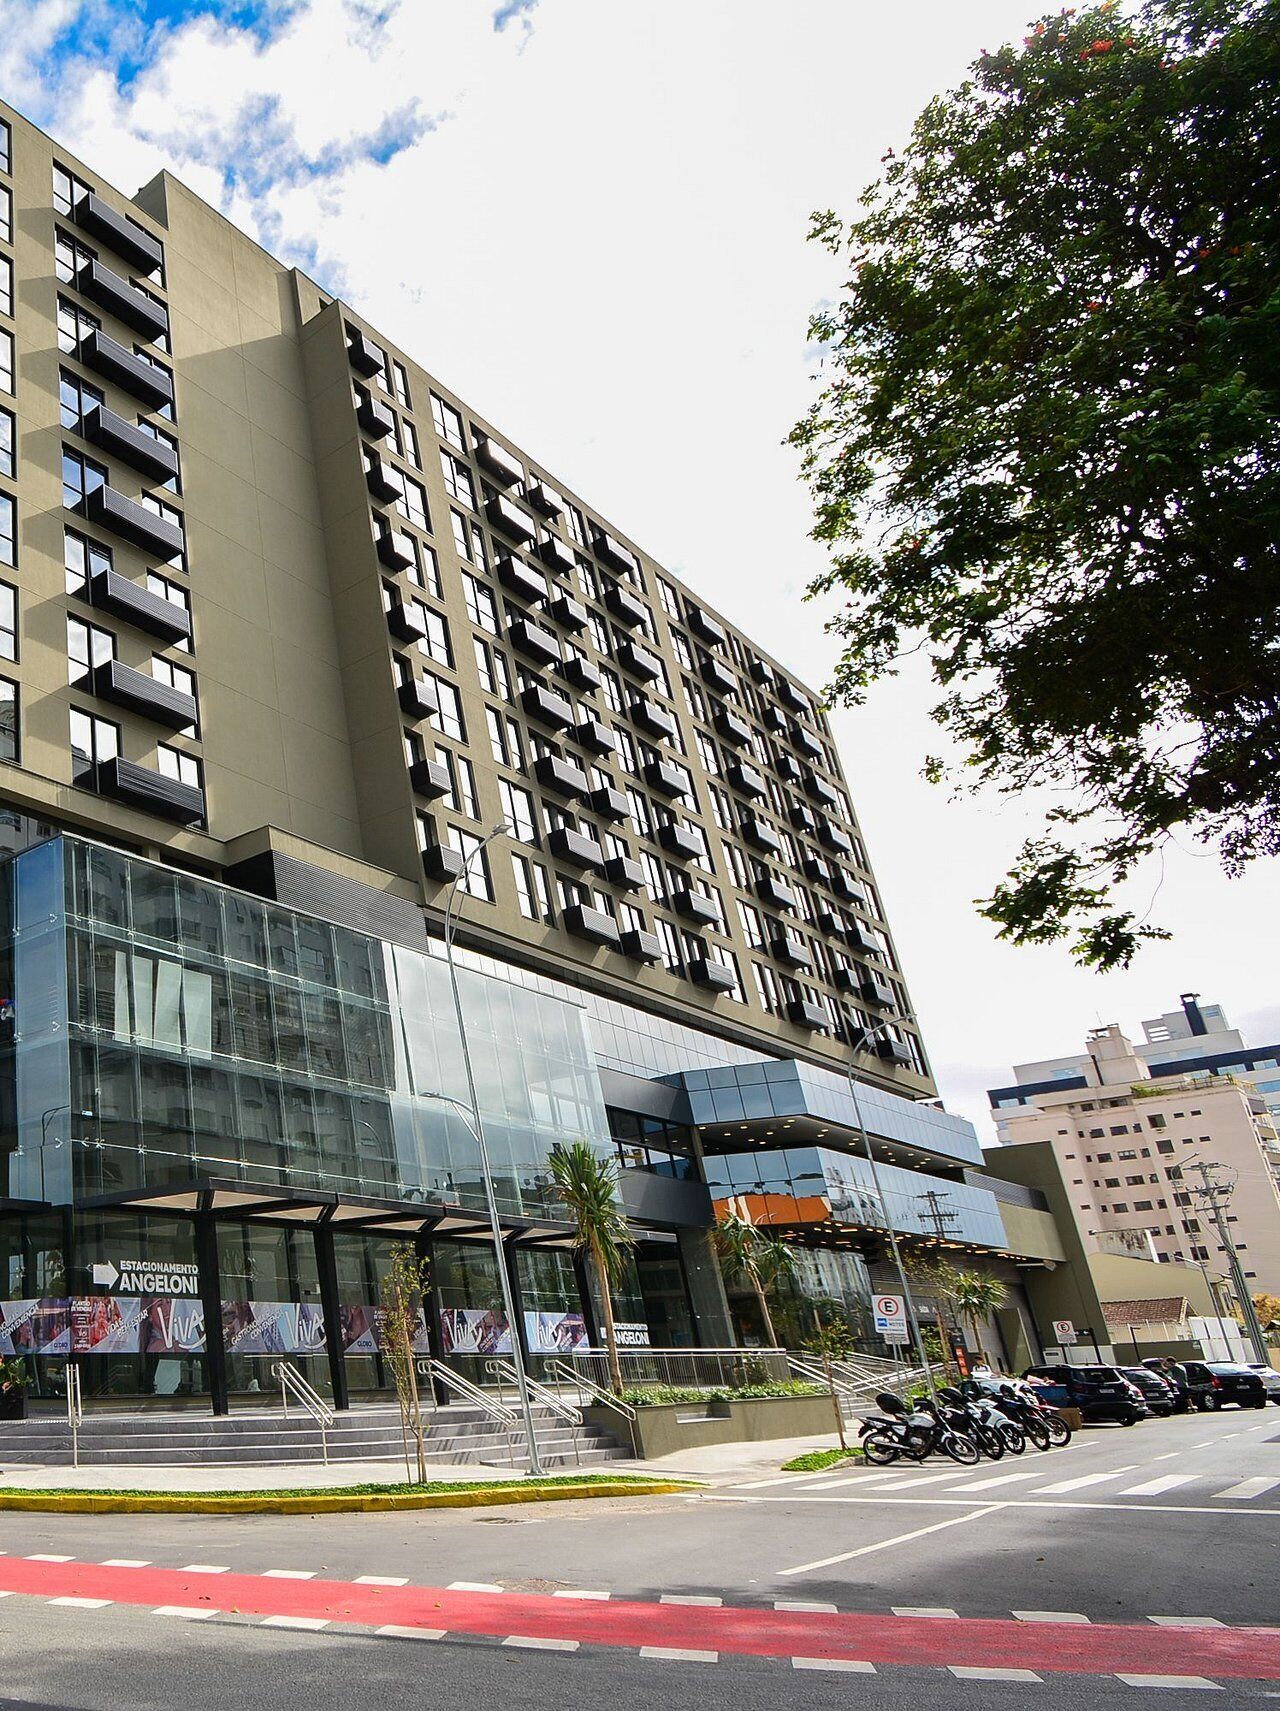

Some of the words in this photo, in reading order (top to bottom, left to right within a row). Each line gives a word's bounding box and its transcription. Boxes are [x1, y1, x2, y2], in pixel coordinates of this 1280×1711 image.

[120, 1259, 199, 1275] ESTACIONAMENTO
[120, 1273, 199, 1294] ANGELONI
[884, 1301, 893, 1312] E
